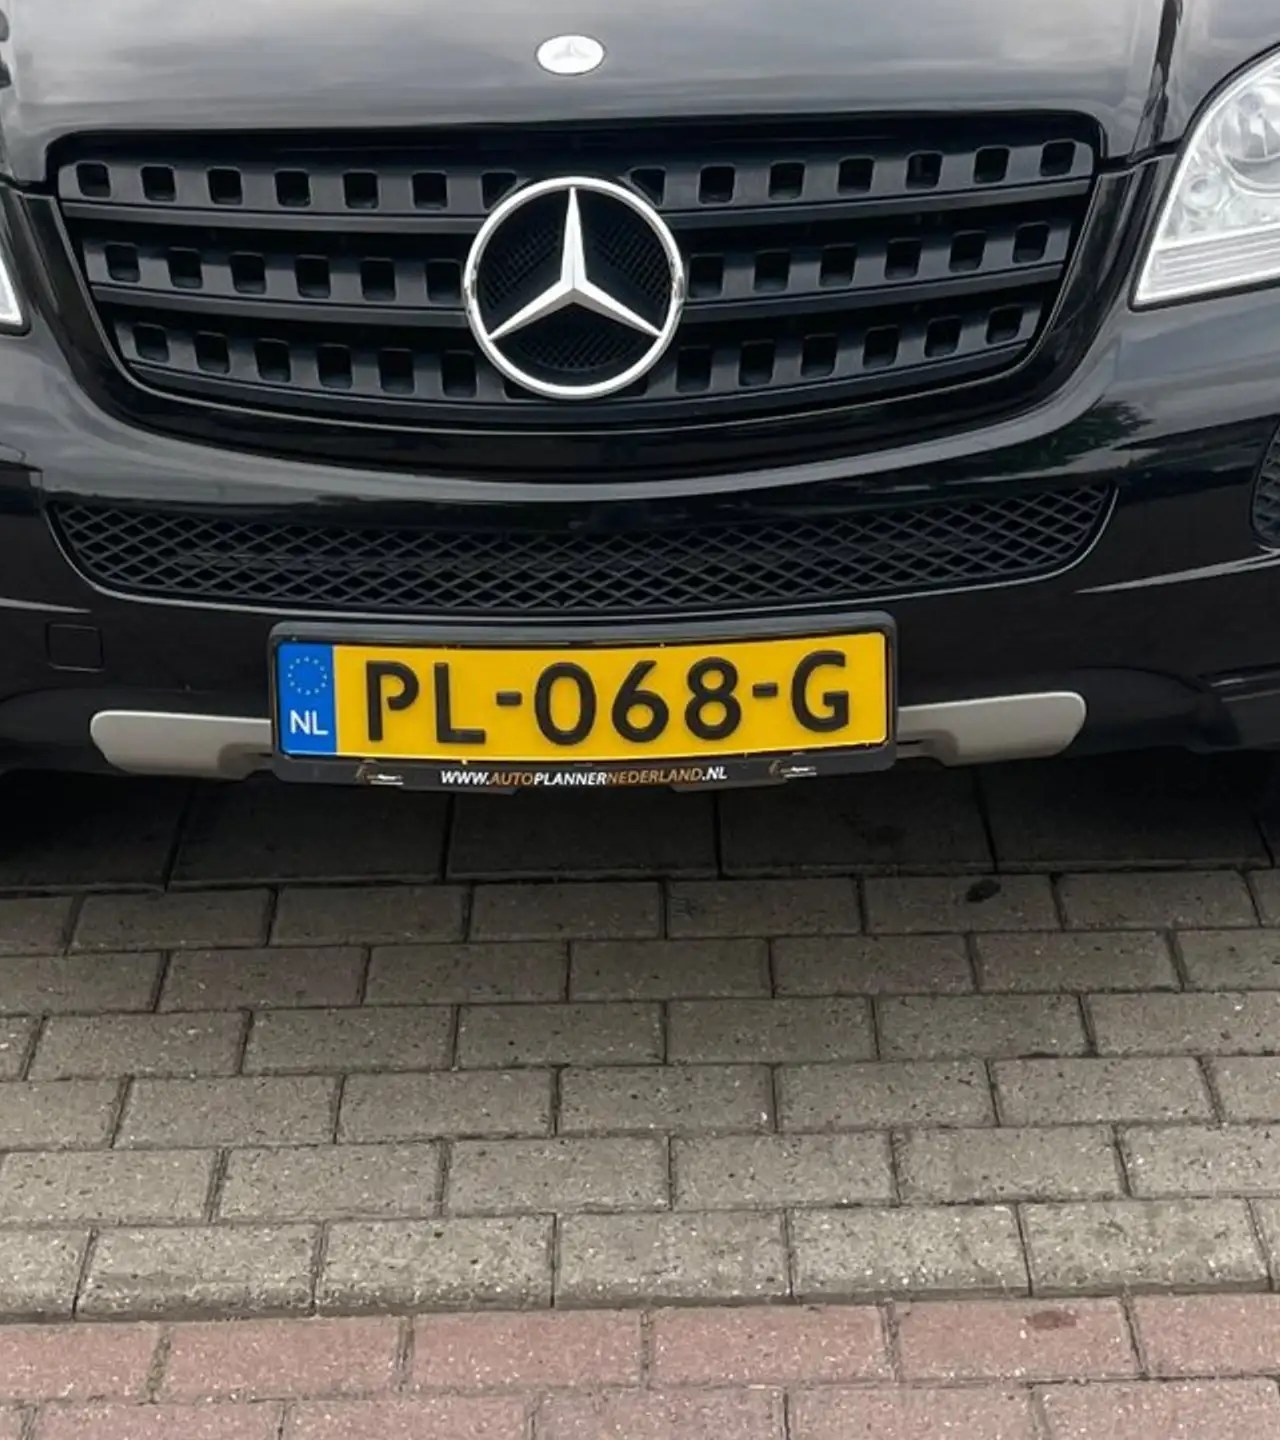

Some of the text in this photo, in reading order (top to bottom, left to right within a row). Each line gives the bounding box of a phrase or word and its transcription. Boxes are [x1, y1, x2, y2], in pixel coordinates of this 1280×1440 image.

[289, 650, 850, 746] NL PL-068-G
[440, 766, 728, 786] WWW.AUTOPLANNERNEDERLAND.NL
